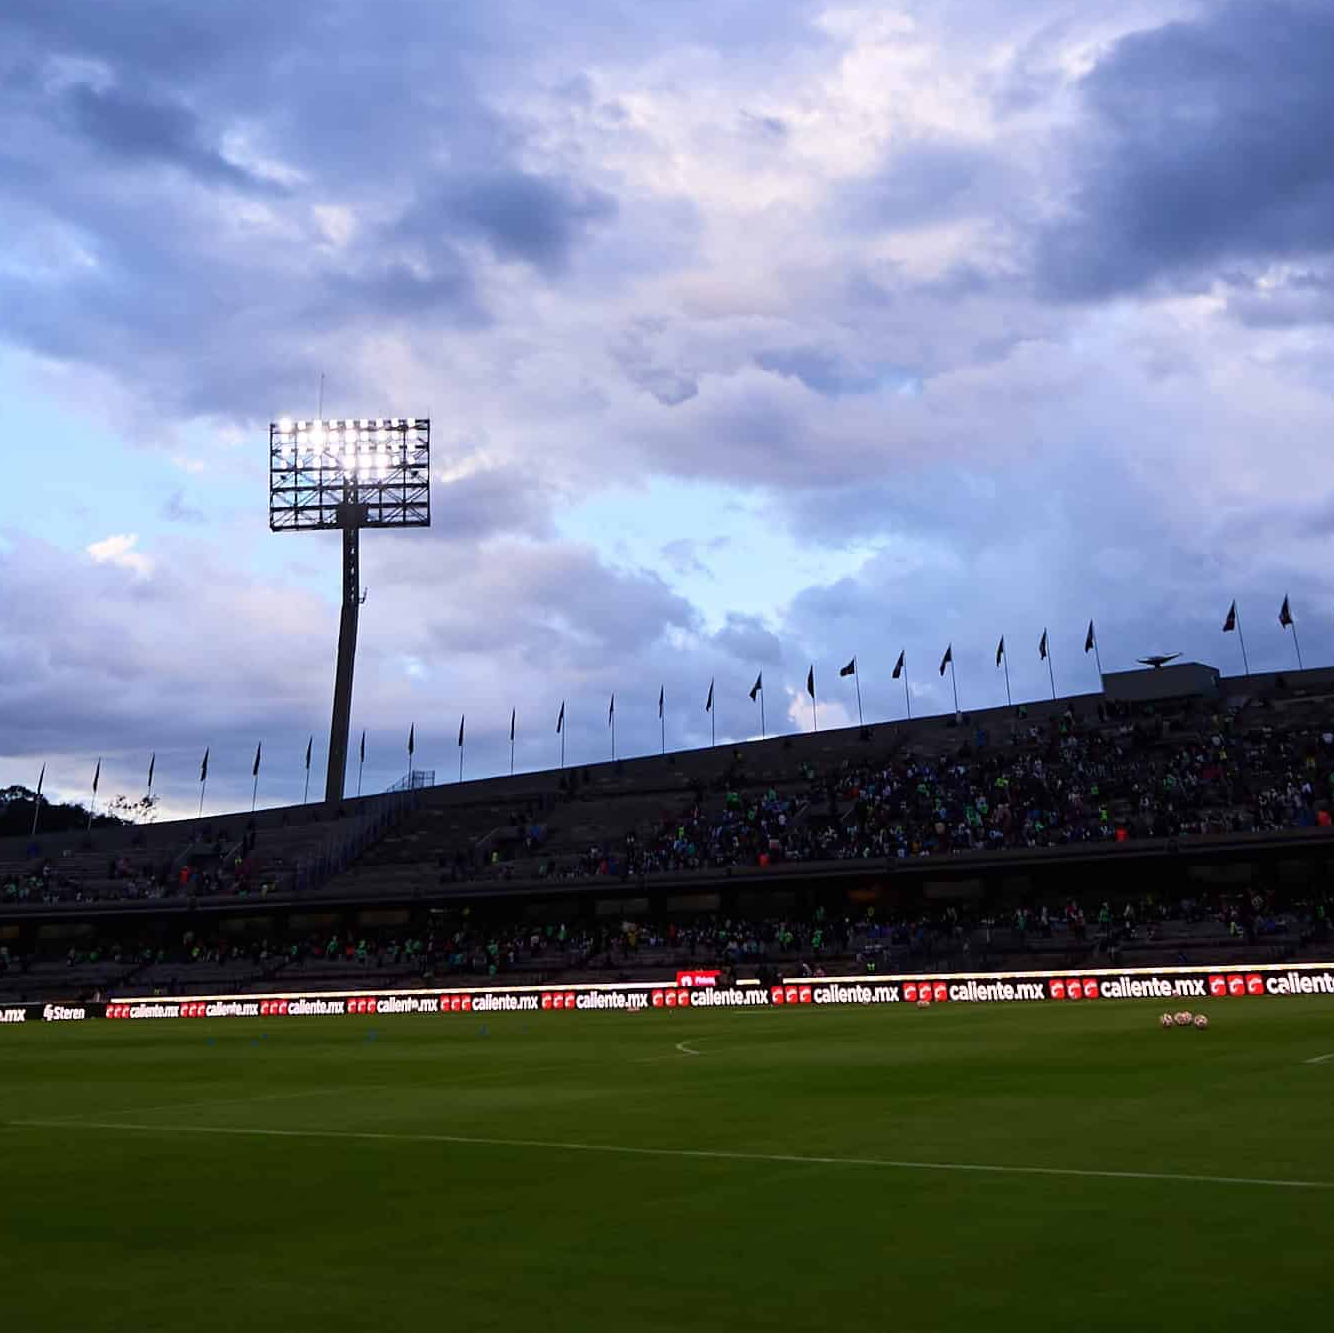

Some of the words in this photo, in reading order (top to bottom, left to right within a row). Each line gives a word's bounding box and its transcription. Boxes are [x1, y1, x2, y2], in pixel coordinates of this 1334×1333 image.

[690, 988, 769, 1006] caliente.mx
[813, 984, 900, 1004] caliente.mx
[949, 981, 1045, 1001] caliente.mx
[1100, 978, 1207, 998] caliente.mx
[206, 1002, 258, 1016] caliente.mx
[287, 1000, 345, 1015] caliente.mx
[472, 994, 539, 1011] caliente.mx
[576, 991, 648, 1009] caliente.mx
[130, 1004, 179, 1018] caliente.mx
